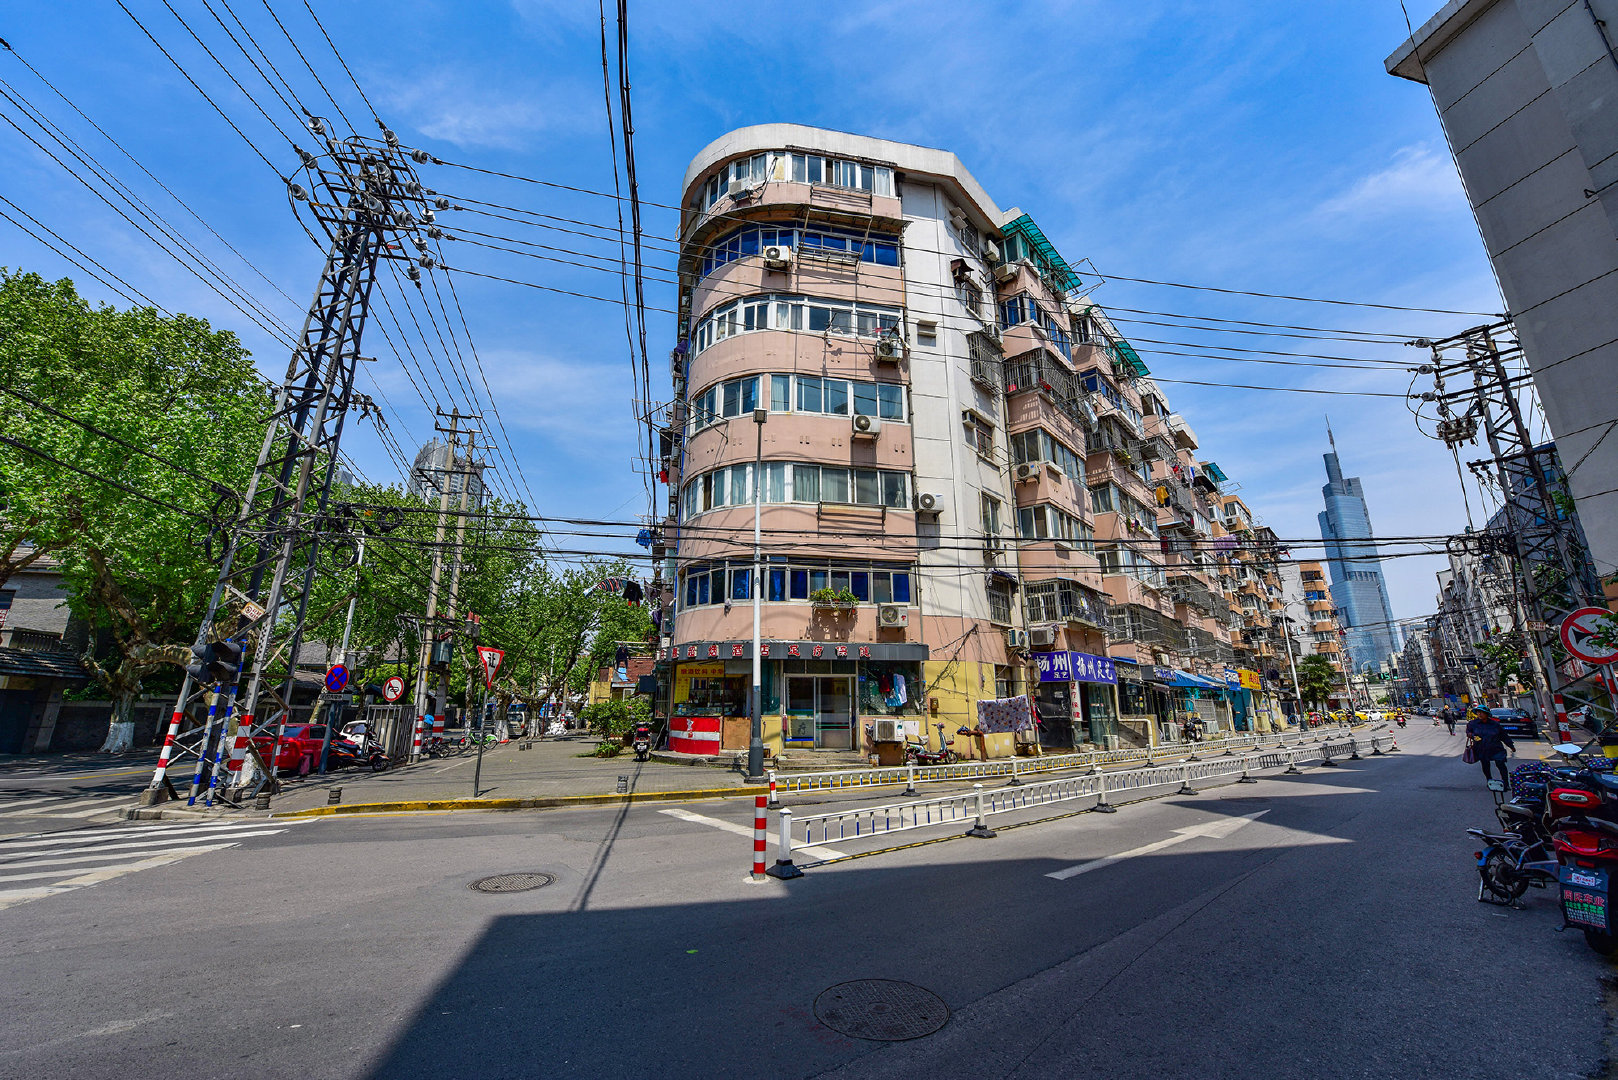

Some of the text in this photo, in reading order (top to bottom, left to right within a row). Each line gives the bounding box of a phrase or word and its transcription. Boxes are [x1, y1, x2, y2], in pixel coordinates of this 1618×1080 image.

[787, 643, 871, 658] 足疗保健
[487, 652, 496, 669] 让
[1034, 653, 1068, 672] 扬州
[1053, 671, 1069, 679] 足艺
[1380, 672, 1391, 680] 15
